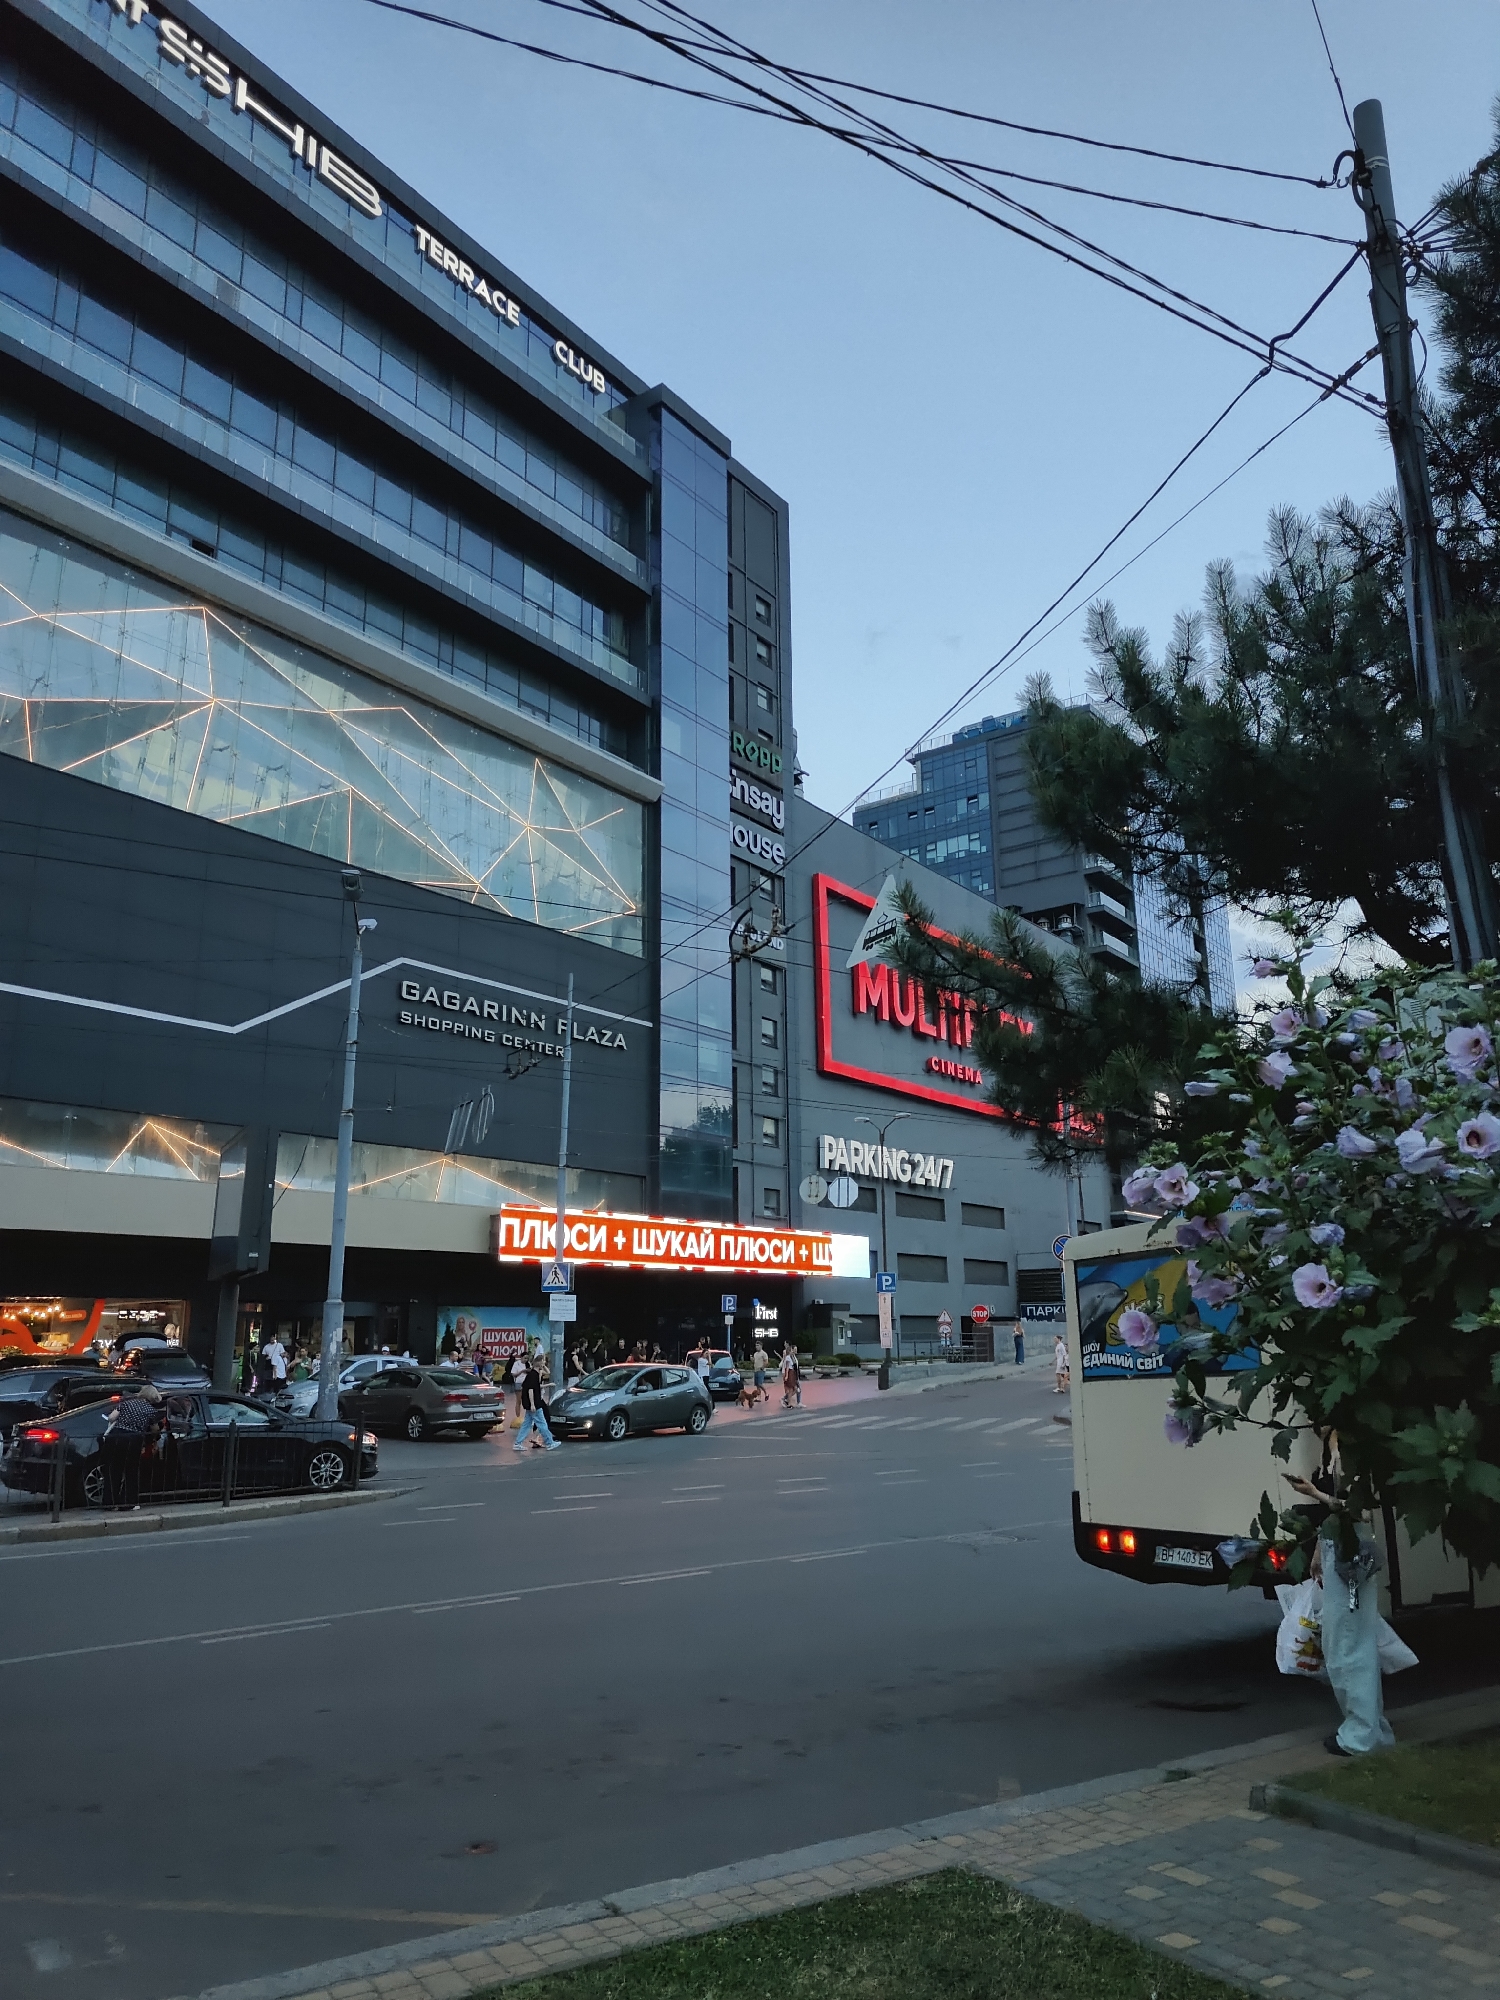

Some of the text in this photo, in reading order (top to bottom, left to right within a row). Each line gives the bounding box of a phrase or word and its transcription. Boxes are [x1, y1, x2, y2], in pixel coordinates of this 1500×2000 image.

[415, 225, 520, 327] TERRACE
[554, 340, 606, 394] CLUB
[729, 769, 785, 830] insay
[401, 980, 627, 1050] GAGARINN PLAZA
[400, 1011, 565, 1058] SHOPPING CENTER
[929, 1055, 983, 1085] CINEMA
[820, 1135, 954, 1189] PARKING 24/7
[500, 1216, 607, 1252] ПЛЮСИ
[633, 1228, 715, 1260] ШУКАЙ
[720, 1235, 795, 1264] ПЛЮСИ
[882, 1276, 892, 1290] P
[726, 1297, 734, 1311] P
[754, 1301, 778, 1320] First
[1027, 1306, 1066, 1316] ПАРКІ
[972, 1310, 988, 1318] STOP
[484, 1330, 523, 1343] ШУКАЙ
[1083, 1343, 1100, 1354] ШОУ
[1161, 1549, 1212, 1566] BH 1403 EK
